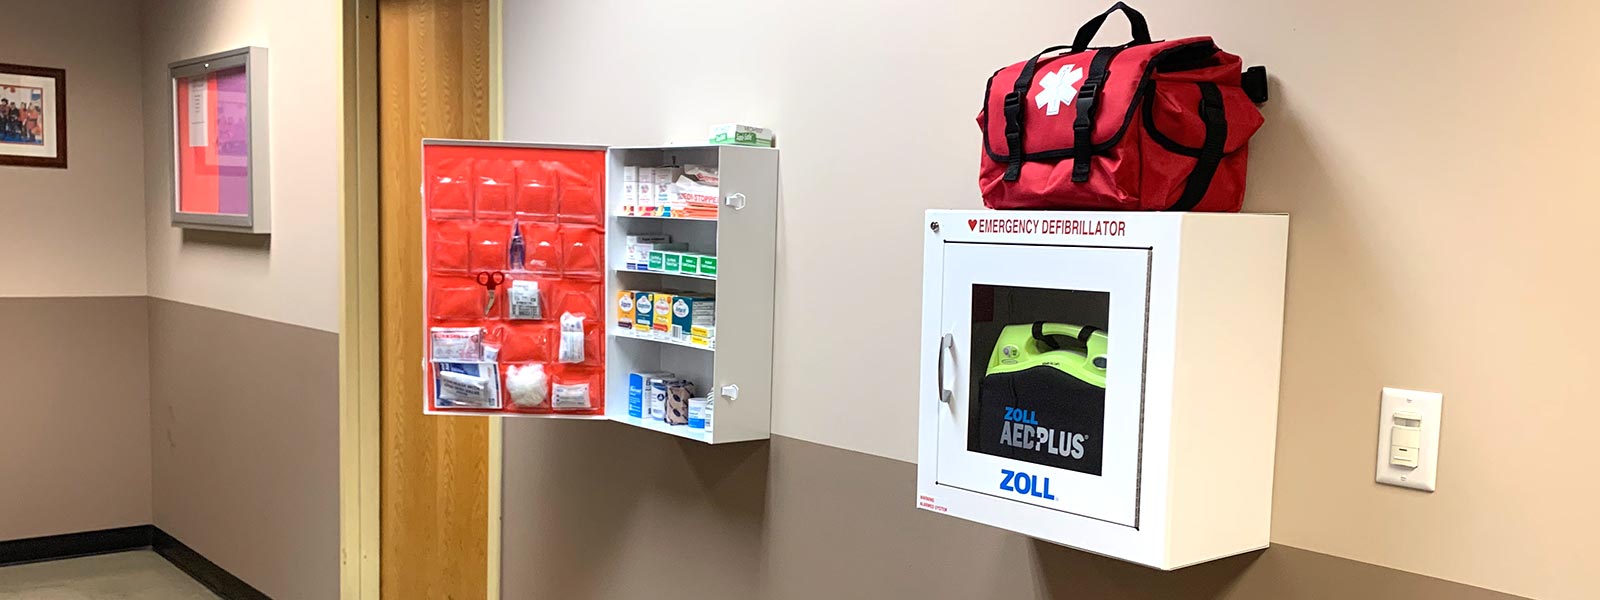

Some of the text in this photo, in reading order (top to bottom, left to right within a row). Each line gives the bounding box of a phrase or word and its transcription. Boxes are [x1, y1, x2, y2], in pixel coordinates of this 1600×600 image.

[979, 219, 1126, 236] EMERGENCY DEFIBRILLATOR
[1004, 406, 1039, 425] ZOLL
[1000, 468, 1055, 500] ZOLL
